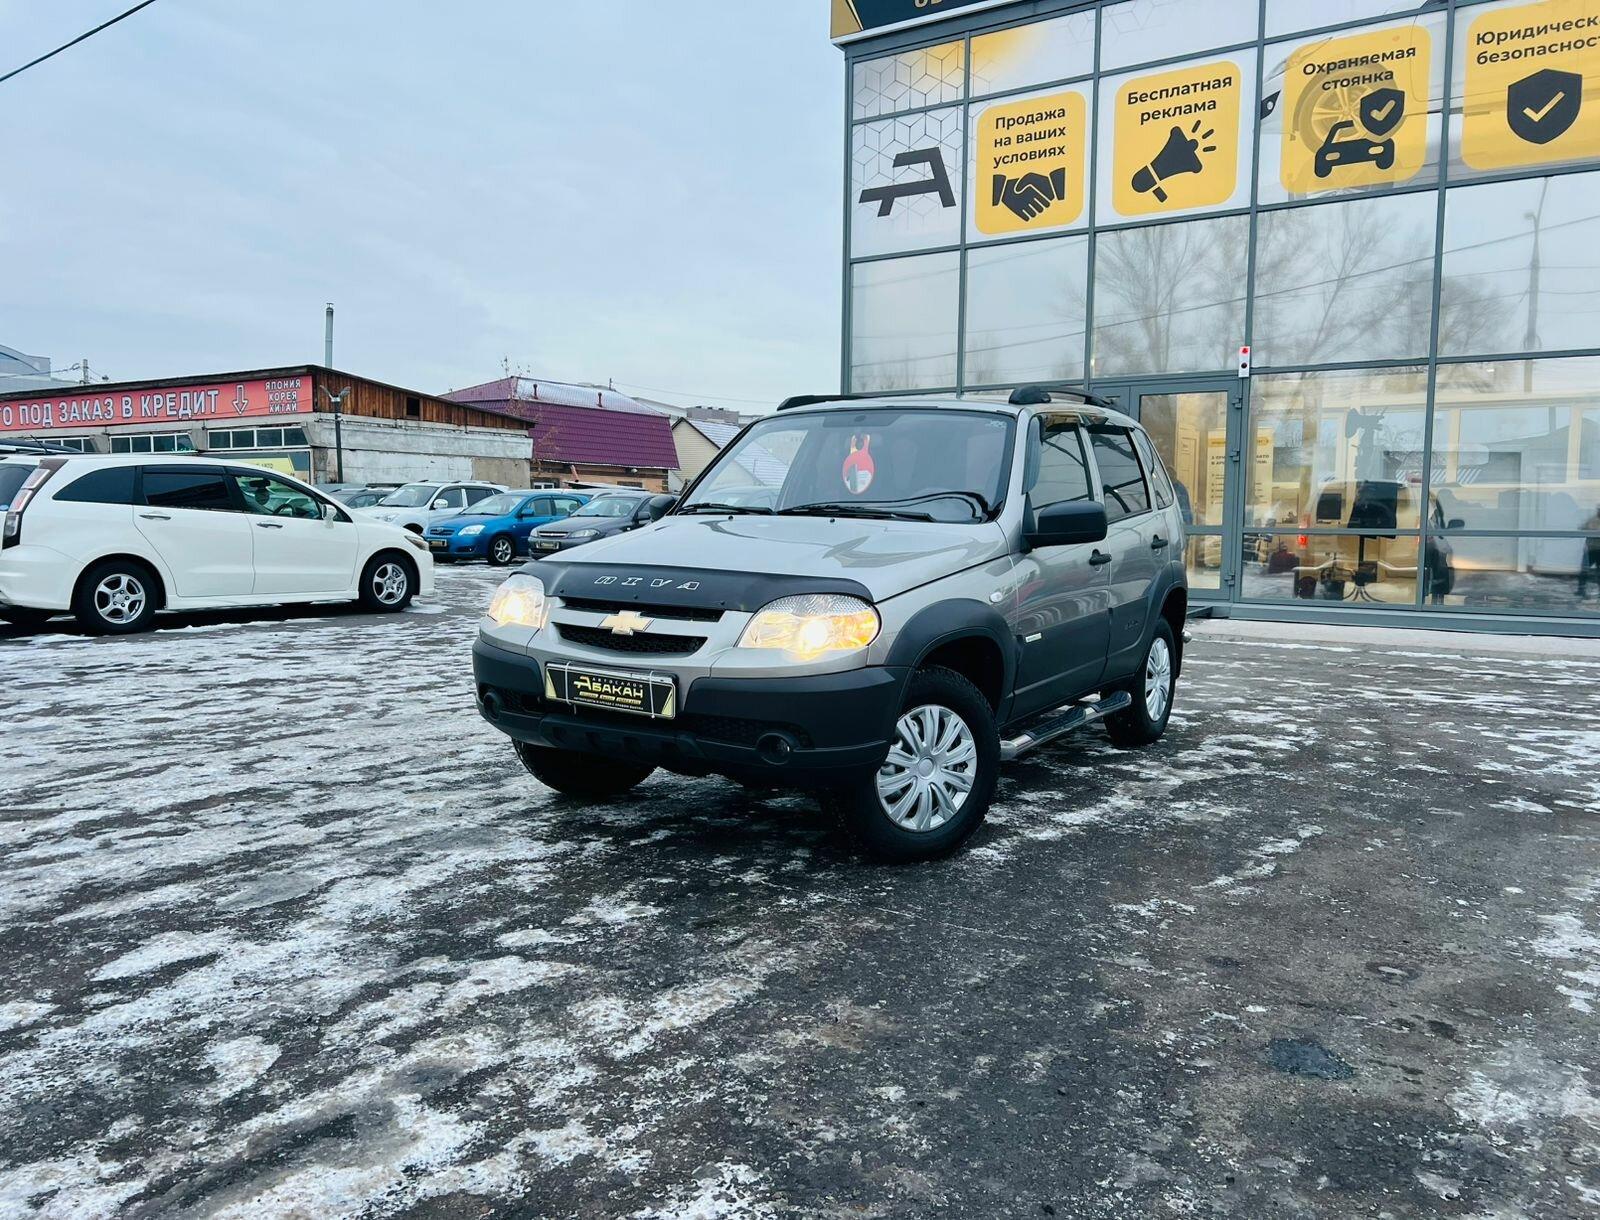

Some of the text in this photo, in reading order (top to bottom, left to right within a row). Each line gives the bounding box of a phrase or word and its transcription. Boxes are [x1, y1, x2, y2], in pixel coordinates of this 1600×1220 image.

[1476, 15, 1600, 46] Юридическ
[1302, 47, 1417, 76] Охраняемая
[1127, 76, 1232, 105] Бесплатная
[1321, 70, 1394, 92] стоянка
[995, 106, 1066, 130] Продажа
[1140, 100, 1217, 125] реклама
[993, 126, 1066, 148] на ваших
[993, 145, 1066, 169] условиях
[265, 379, 301, 391] ЯПОНИЯ
[268, 391, 297, 401] КОРЕЯ
[19, 403, 53, 428] ПОД
[59, 398, 114, 422] ЗАКАЗ
[122, 396, 133, 418] В
[141, 390, 219, 419] КРЕДИТ
[269, 401, 297, 413] КИТАЙ
